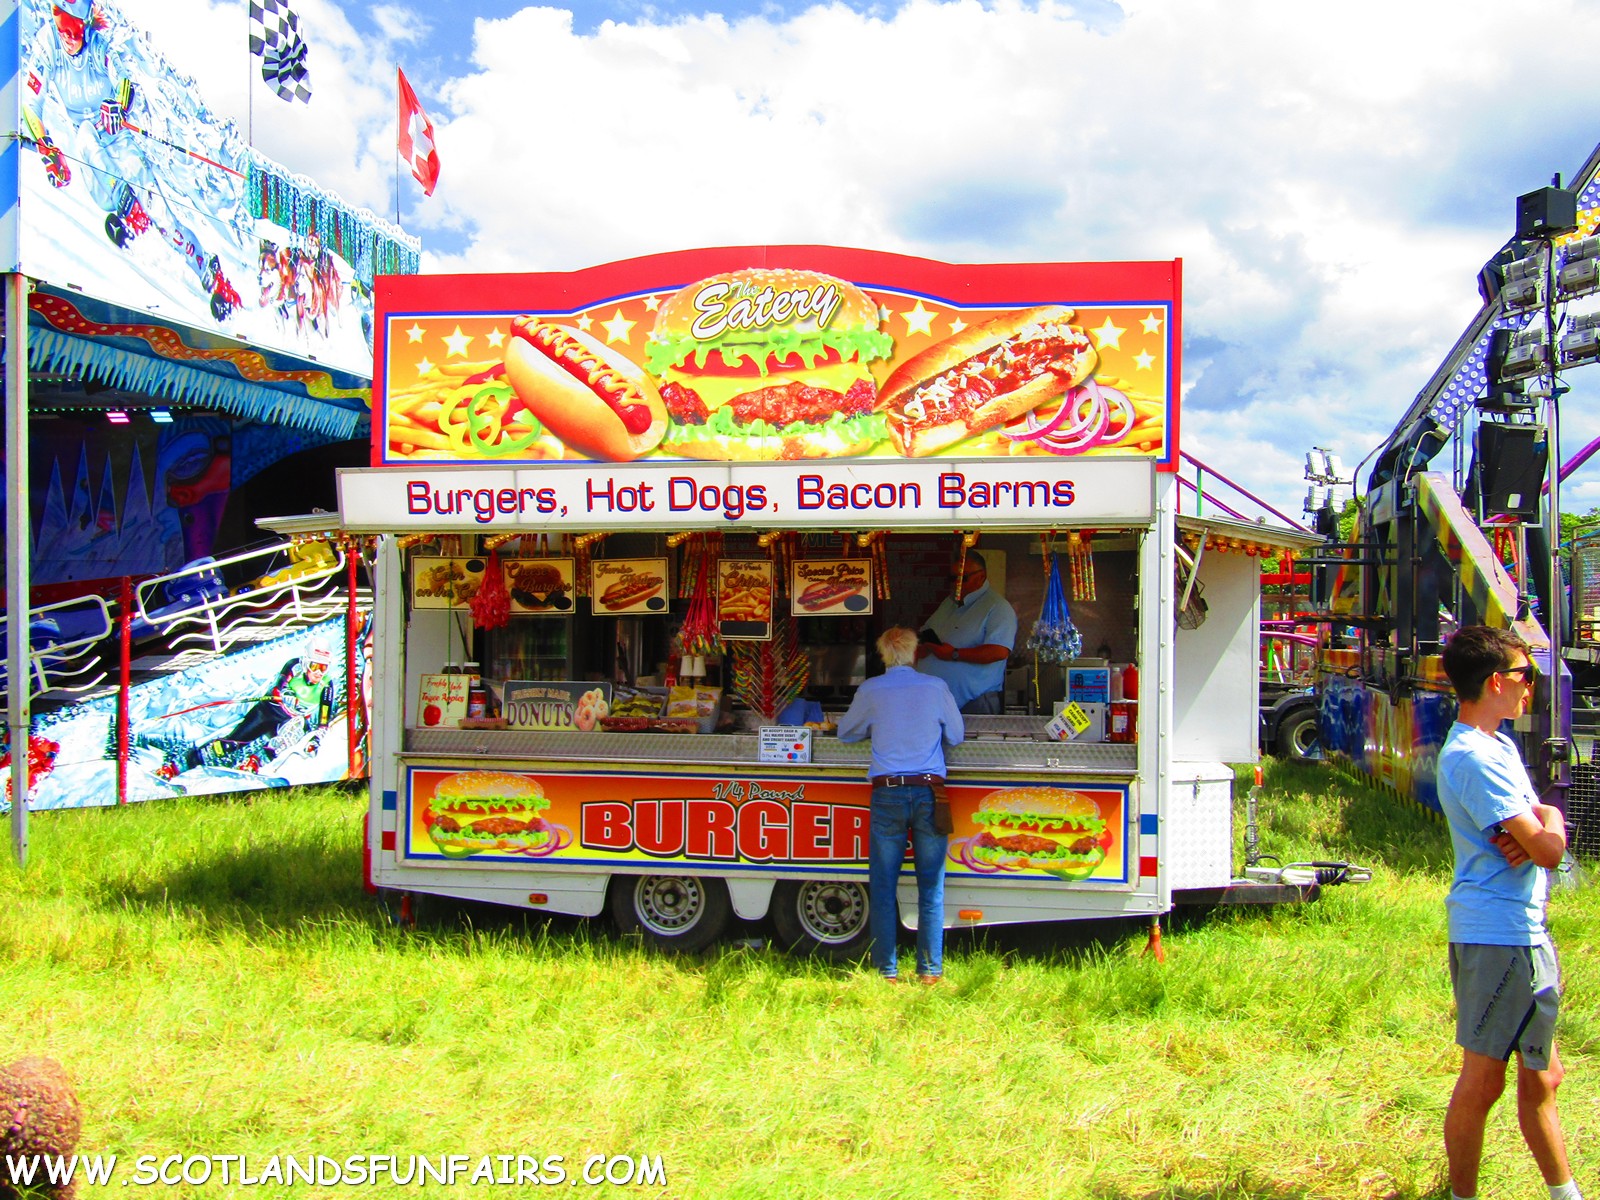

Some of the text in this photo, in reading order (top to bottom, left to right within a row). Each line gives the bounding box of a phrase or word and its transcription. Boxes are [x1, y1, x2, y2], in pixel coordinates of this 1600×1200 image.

[730, 279, 759, 299] The
[691, 282, 840, 340] Eatery
[406, 472, 1076, 523] Burgers, Hot Dogs, Bacon Barms
[506, 562, 548, 579] Cheese
[596, 563, 633, 579] Jumbo
[798, 563, 865, 580] Special Price
[520, 577, 573, 597] Burgers
[721, 570, 769, 592] Chips
[416, 588, 433, 598] on
[507, 701, 574, 727] DONUTS
[1069, 709, 1078, 720] CASH
[1076, 709, 1088, 724] ACCEPT
[712, 780, 805, 802] 1/4 Pound
[581, 798, 914, 863] BURGER
